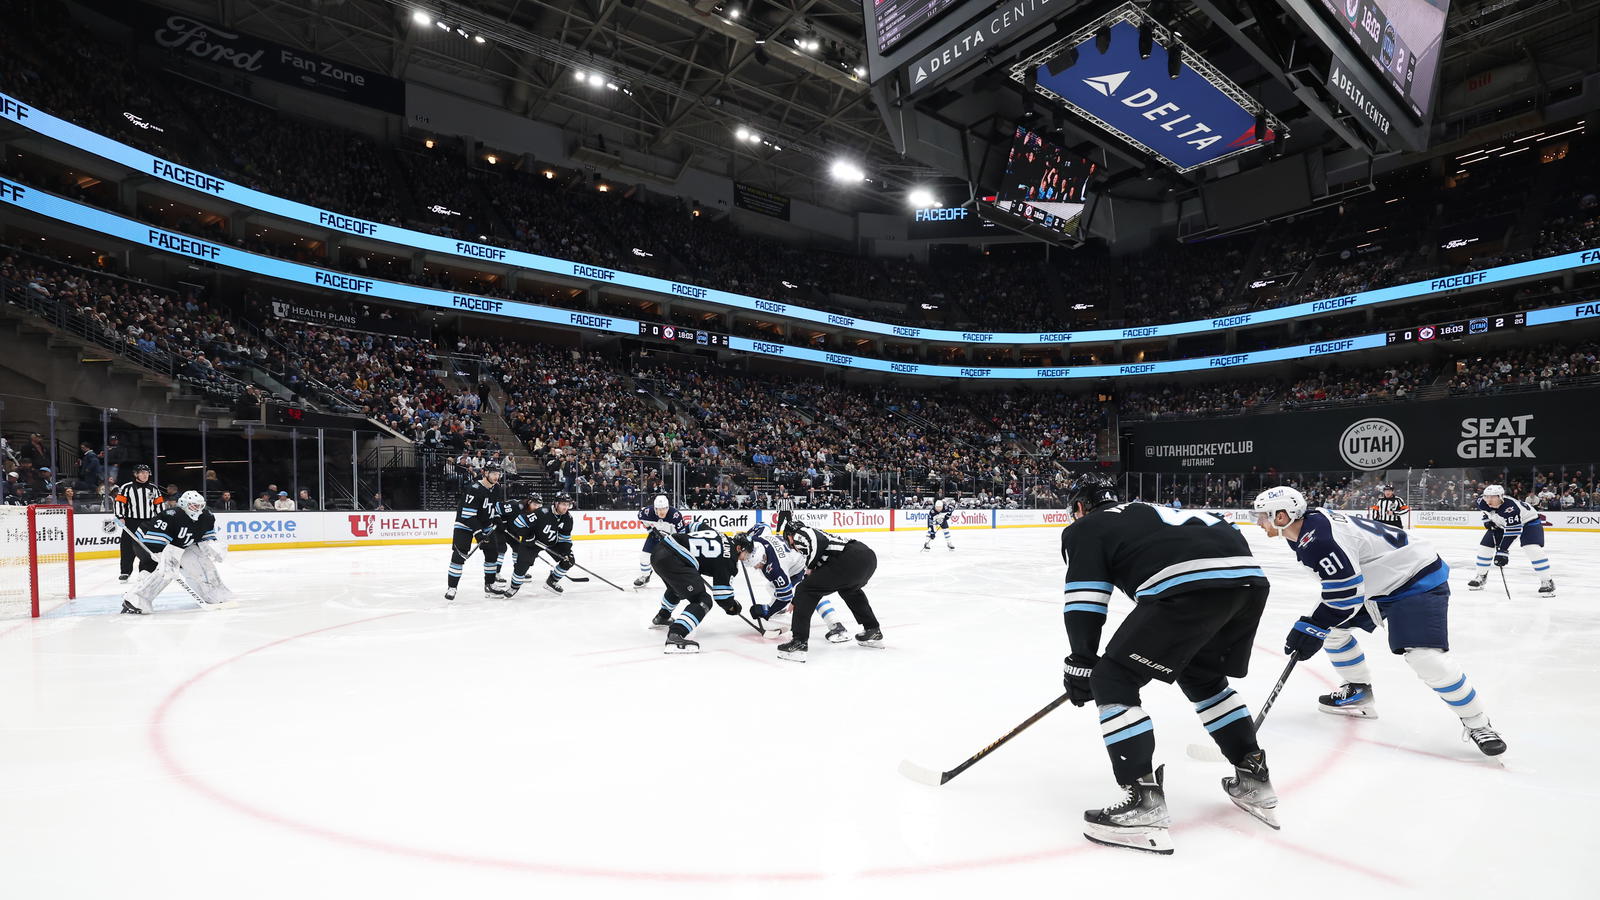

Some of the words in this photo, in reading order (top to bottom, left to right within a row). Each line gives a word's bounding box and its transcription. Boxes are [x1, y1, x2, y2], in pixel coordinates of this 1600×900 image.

[1361, 5, 1381, 43] 18:03
[154, 16, 264, 71] Ford
[931, 29, 985, 71] DELTA
[280, 49, 316, 73] Fan
[320, 61, 365, 86] Zone
[1396, 48, 1405, 73] 2
[1340, 73, 1364, 110] DELTA
[1365, 102, 1391, 136] CENTER
[1121, 88, 1223, 151] DELTA
[153, 159, 225, 194] FACEOFF
[916, 208, 968, 222] FACEOFF
[320, 212, 377, 236] FACEOFF
[149, 229, 221, 260] FACEOFF
[456, 242, 506, 260] FACEOFF
[574, 264, 615, 281] FACEOFF
[315, 271, 373, 293] FACEOFF
[1431, 272, 1487, 291] FACEOFF
[672, 283, 707, 298] FACEOFF
[453, 295, 503, 313] FACEOFF
[755, 300, 786, 313] FACEOFF
[1312, 296, 1357, 312] FACEOFF
[292, 306, 327, 320] HEALTH
[328, 312, 357, 325] PLANS
[570, 313, 612, 329] FACEOFF
[828, 314, 855, 326] FACEOFF
[1213, 315, 1251, 328] FACEOFF
[653, 326, 659, 335] 0
[678, 331, 694, 340] 18:03
[711, 335, 718, 344] 2
[893, 326, 920, 337] FACEOFF
[963, 333, 993, 341] FACEOFF
[1122, 327, 1158, 337] FACEOFF
[1404, 331, 1412, 340] 0
[1440, 325, 1464, 335] 18:03
[1495, 318, 1504, 328] 2
[1040, 333, 1072, 342] FACEOFF
[753, 342, 784, 354] FACEOFF
[1309, 340, 1354, 354] FACEOFF
[826, 353, 853, 365] FACEOFF
[1210, 354, 1249, 368] FACEOFF
[891, 363, 919, 373] FACEOFF
[960, 368, 991, 377] FACEOFF
[1037, 369, 1070, 377] FACEOFF
[1120, 364, 1155, 374] FACEOFF
[1353, 424, 1390, 435] HOCKEY
[1461, 414, 1534, 438] SEAT
[1145, 440, 1254, 458] @UTAHHOCKEYCLUB
[1349, 435, 1393, 454] UTAH
[1456, 436, 1537, 459] GEEK
[1182, 457, 1215, 467] #UTAHHC
[1359, 457, 1383, 465] CLUB
[153, 519, 168, 531] 39
[380, 518, 438, 530] HEALTH
[526, 512, 538, 523] 15
[693, 515, 717, 527] Ken
[719, 514, 748, 527] Garff
[833, 511, 853, 526] Rio
[854, 510, 884, 526] Tinto
[960, 510, 988, 526] Smith's
[1508, 515, 1520, 523] 64
[226, 520, 297, 533] moxie
[1319, 551, 1344, 576] 81
[774, 576, 786, 587] 19
[1129, 653, 1173, 675] BAUER
